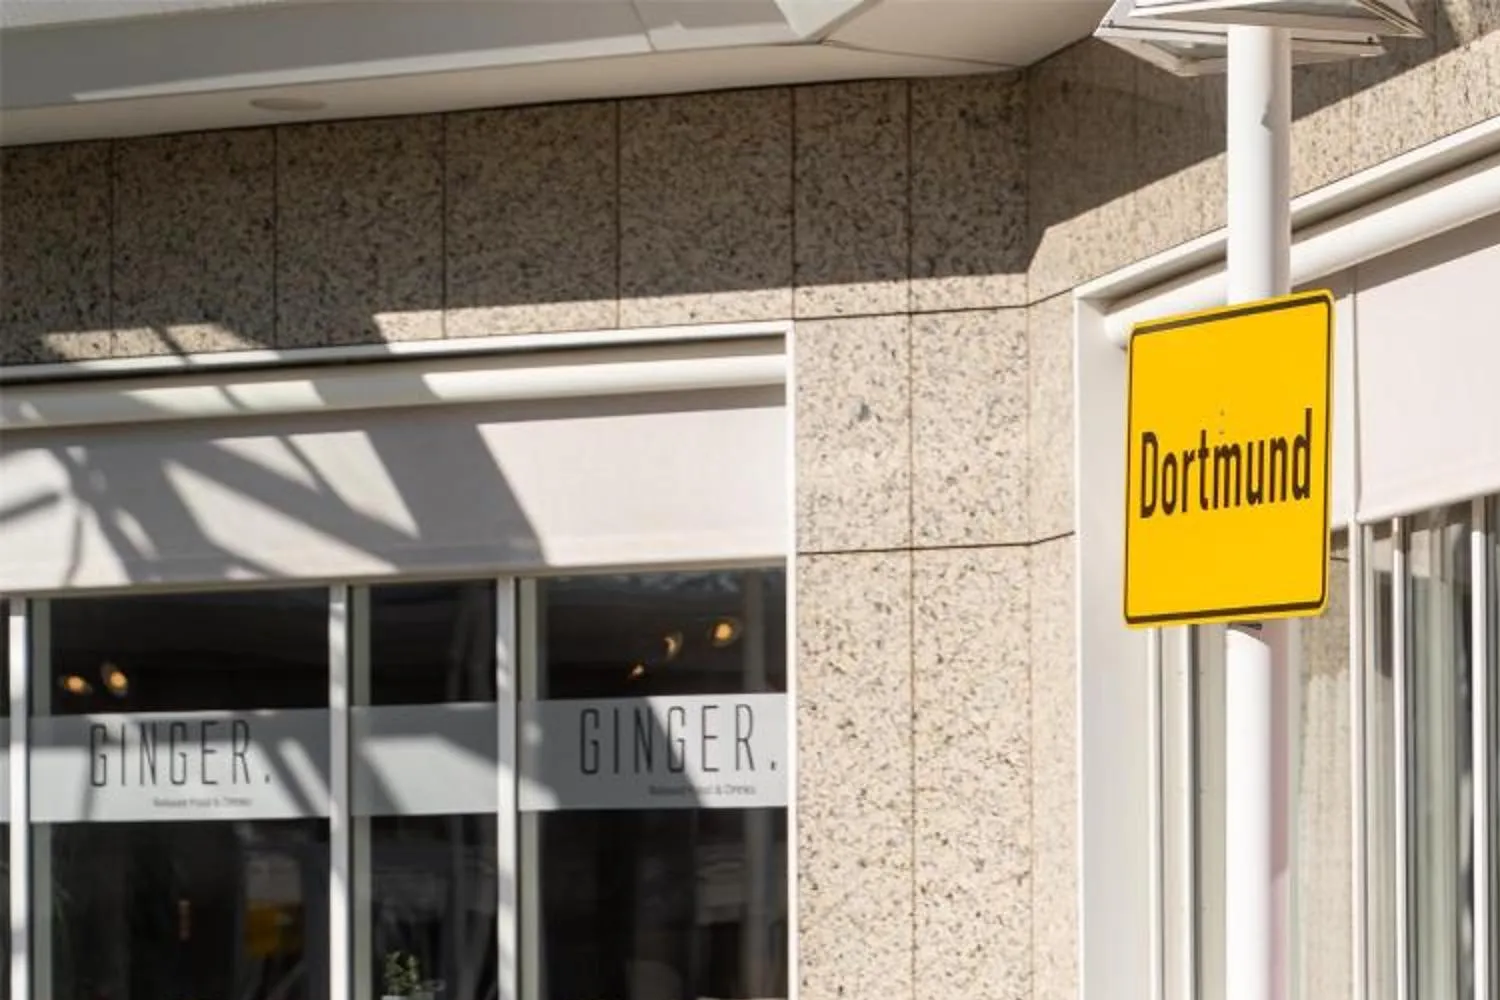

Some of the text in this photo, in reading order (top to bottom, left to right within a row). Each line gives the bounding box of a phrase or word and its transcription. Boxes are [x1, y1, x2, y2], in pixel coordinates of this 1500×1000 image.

[1140, 407, 1313, 519] Dortmund
[90, 719, 271, 787] GINGER.
[579, 703, 777, 775] GINGER.
